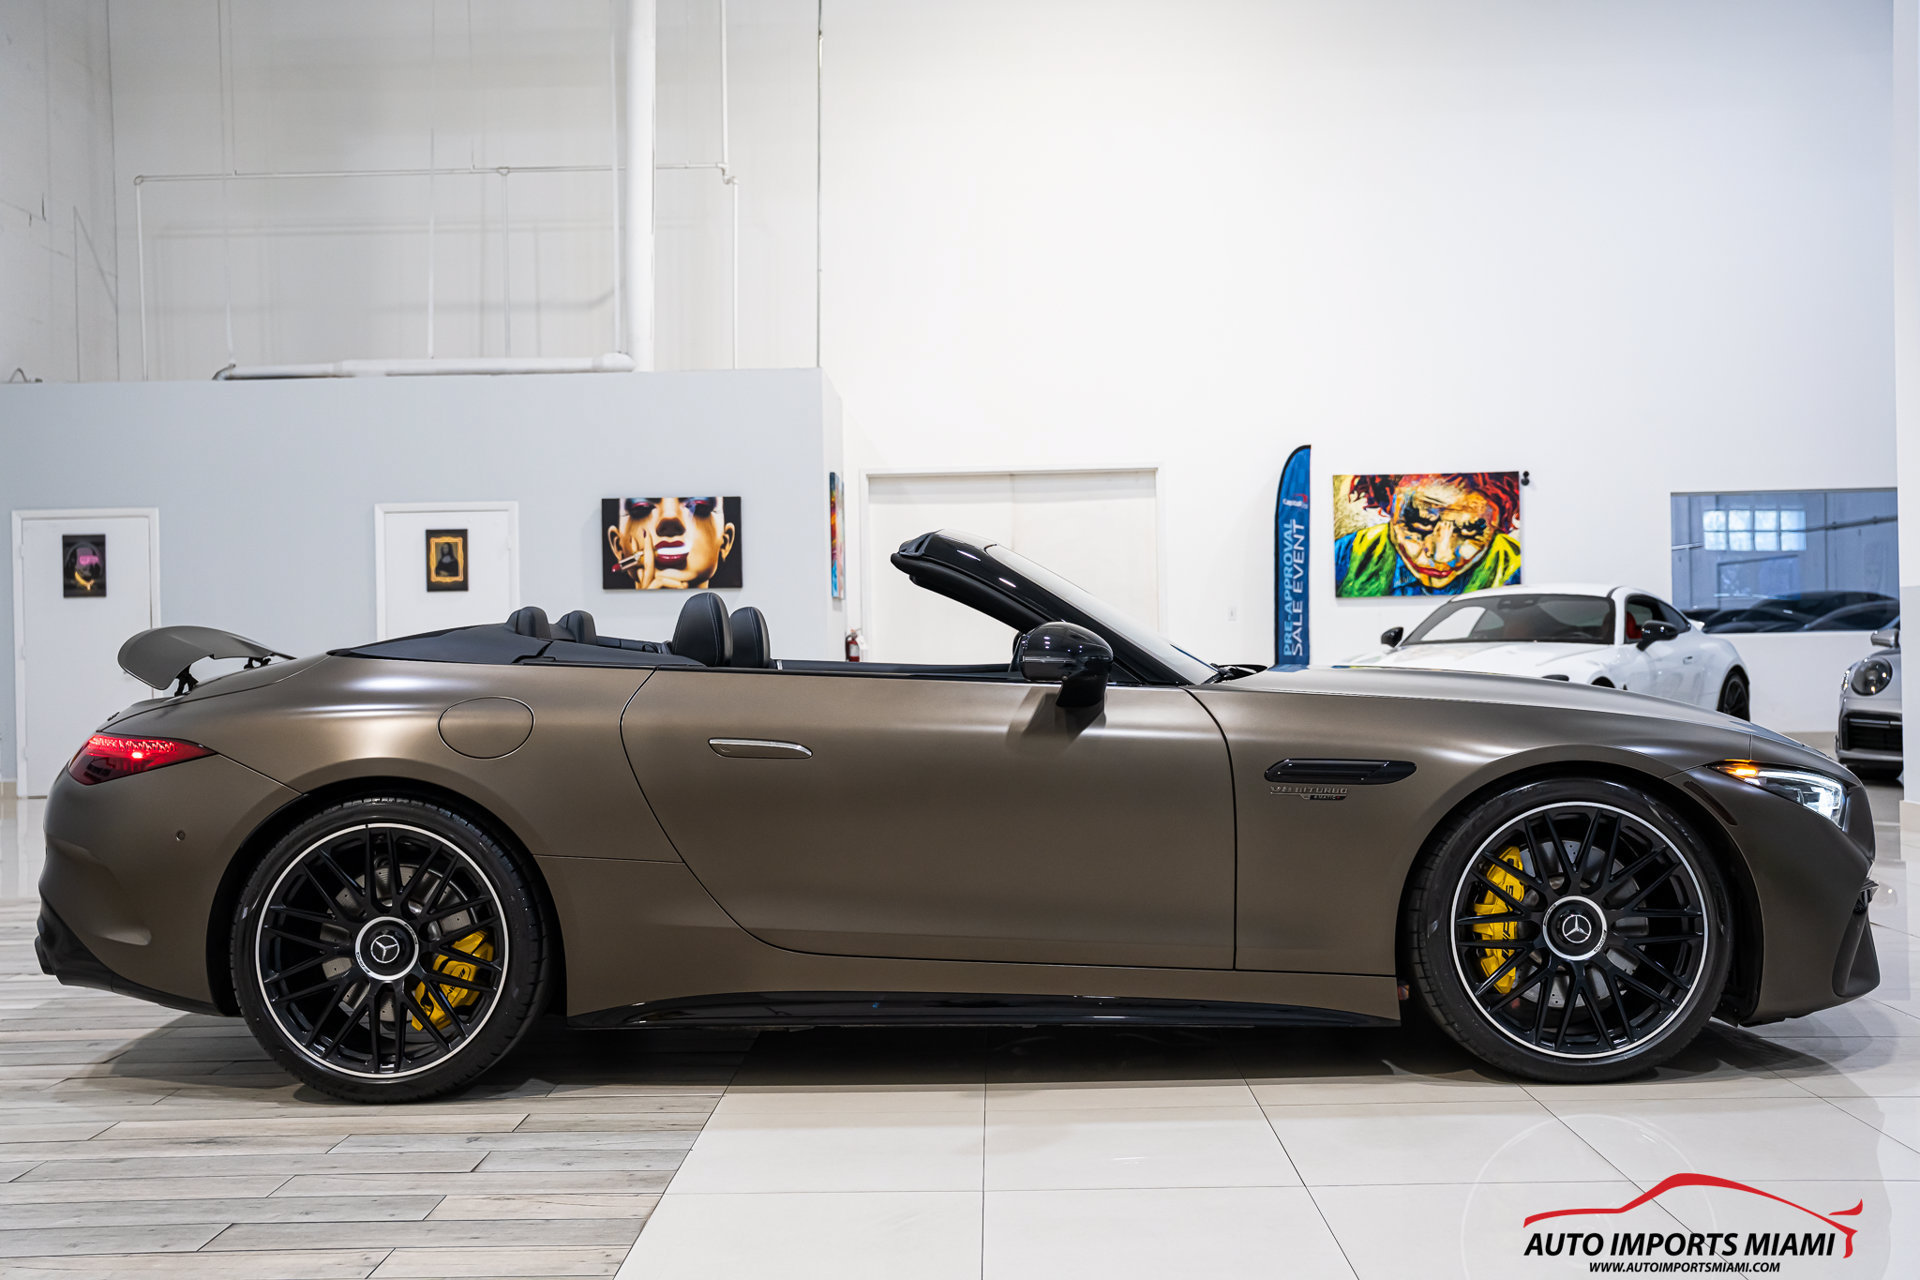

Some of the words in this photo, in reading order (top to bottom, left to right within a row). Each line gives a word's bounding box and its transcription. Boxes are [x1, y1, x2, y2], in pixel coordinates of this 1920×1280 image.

[1283, 520, 1293, 656] PRE-APPROVAL
[1292, 518, 1305, 594] EVENT
[1292, 600, 1303, 657] SALE
